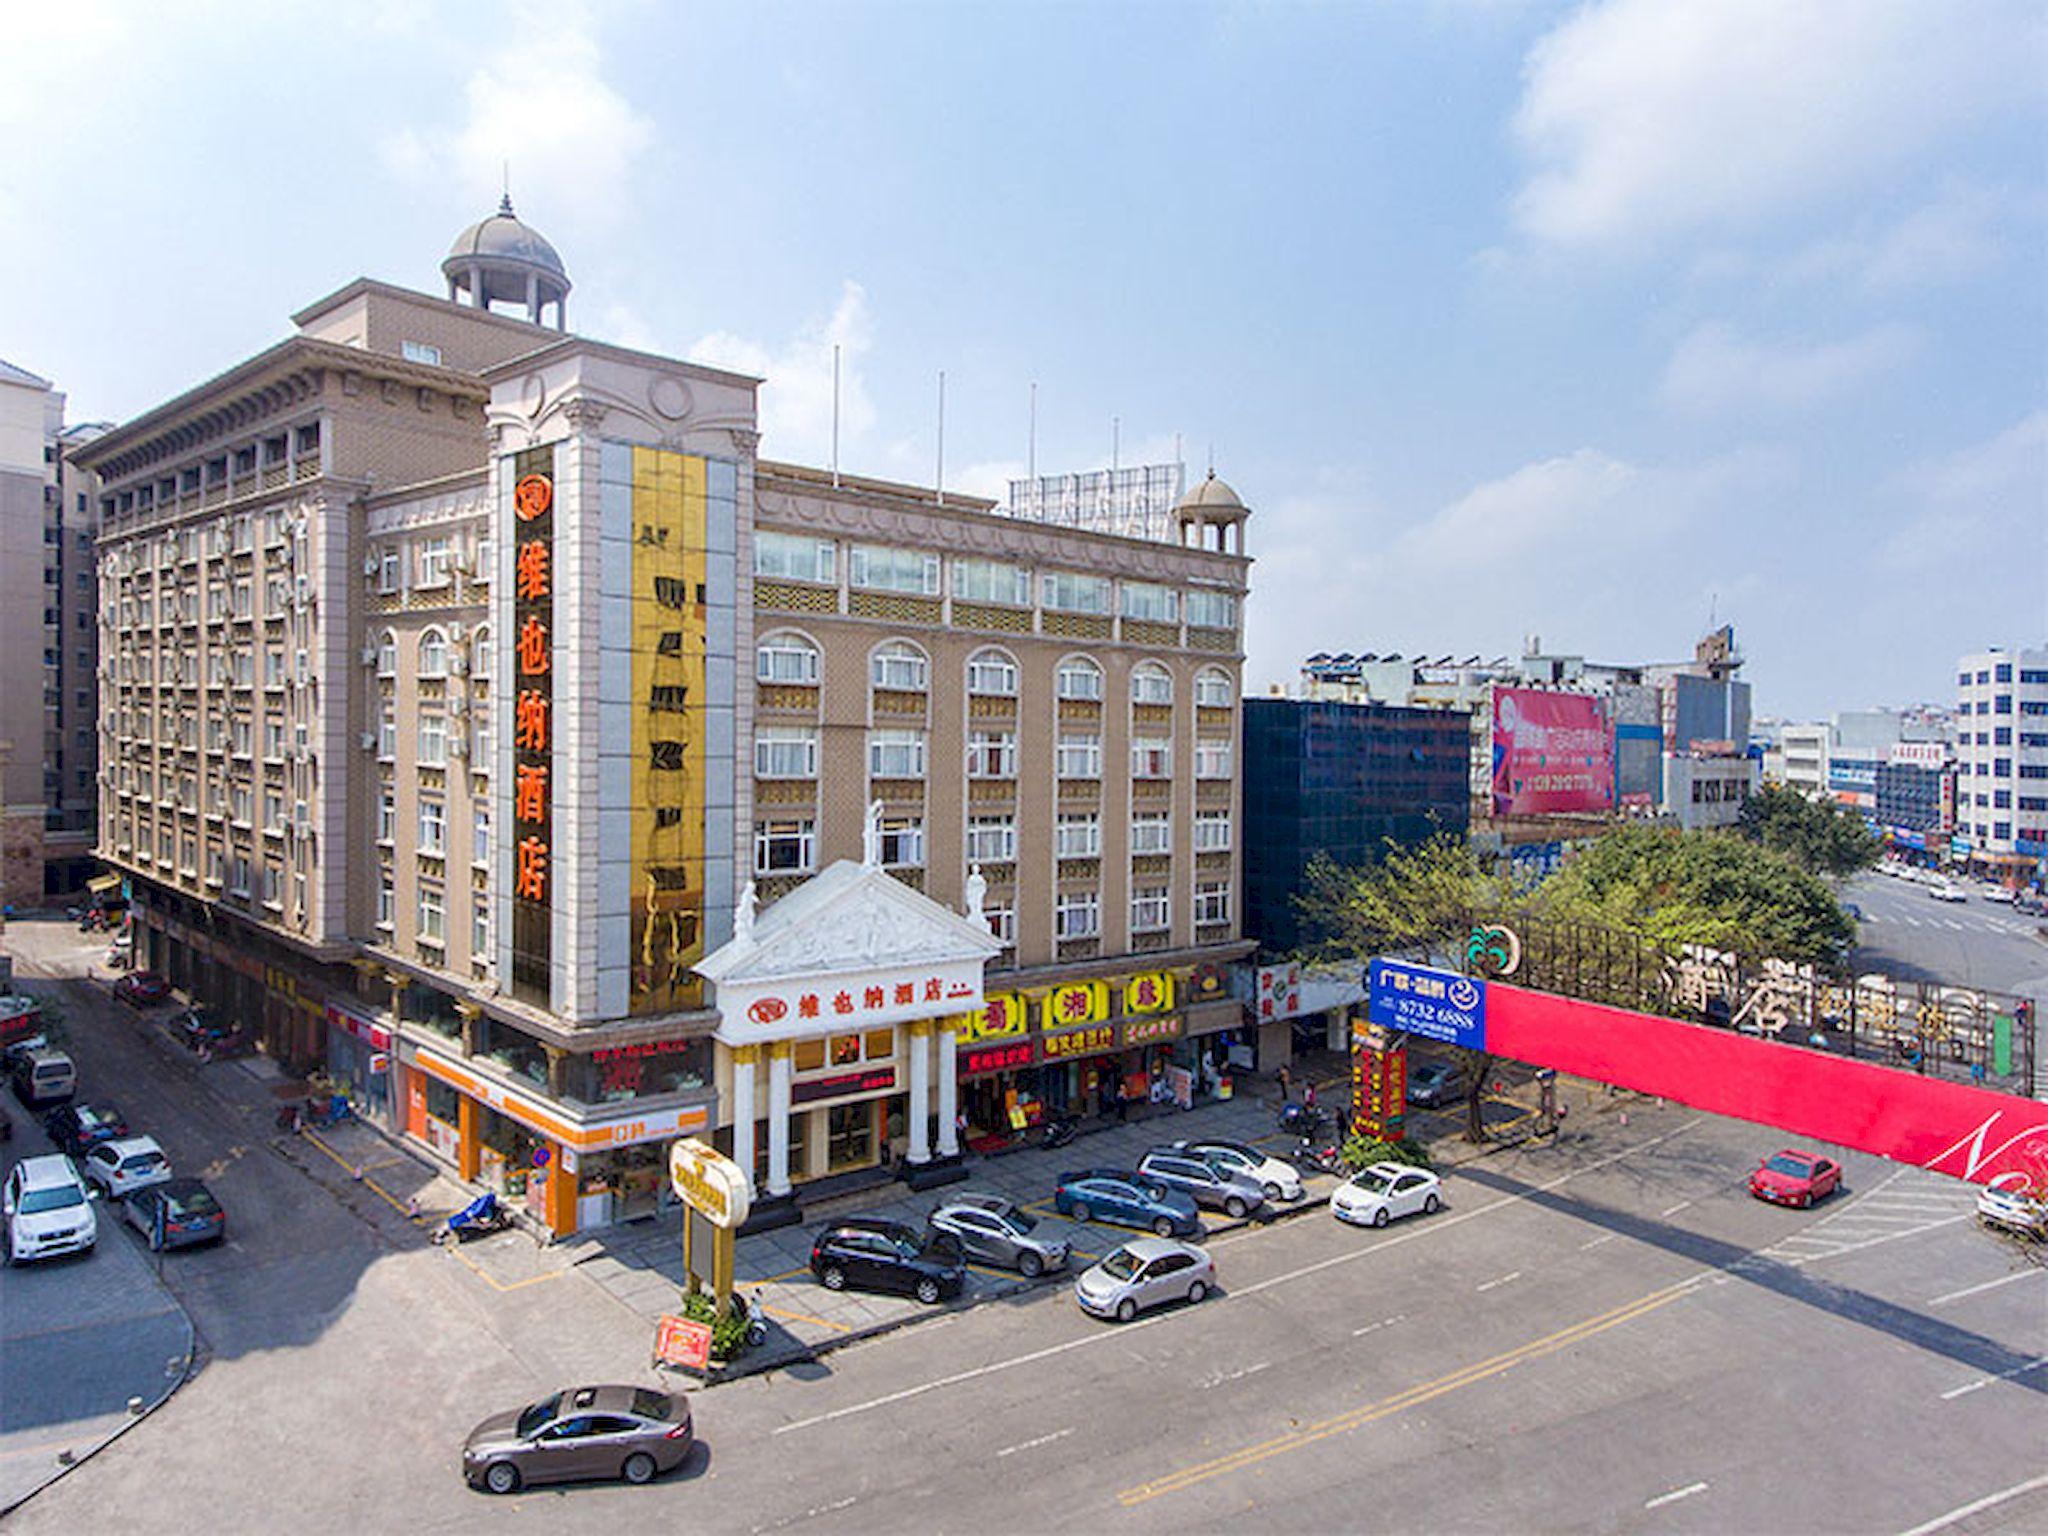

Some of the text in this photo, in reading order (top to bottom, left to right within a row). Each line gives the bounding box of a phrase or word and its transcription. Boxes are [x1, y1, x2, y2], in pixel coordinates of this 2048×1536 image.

[516, 540, 549, 900] 维也纳酒店
[798, 977, 943, 1019] 维也纳酒店
